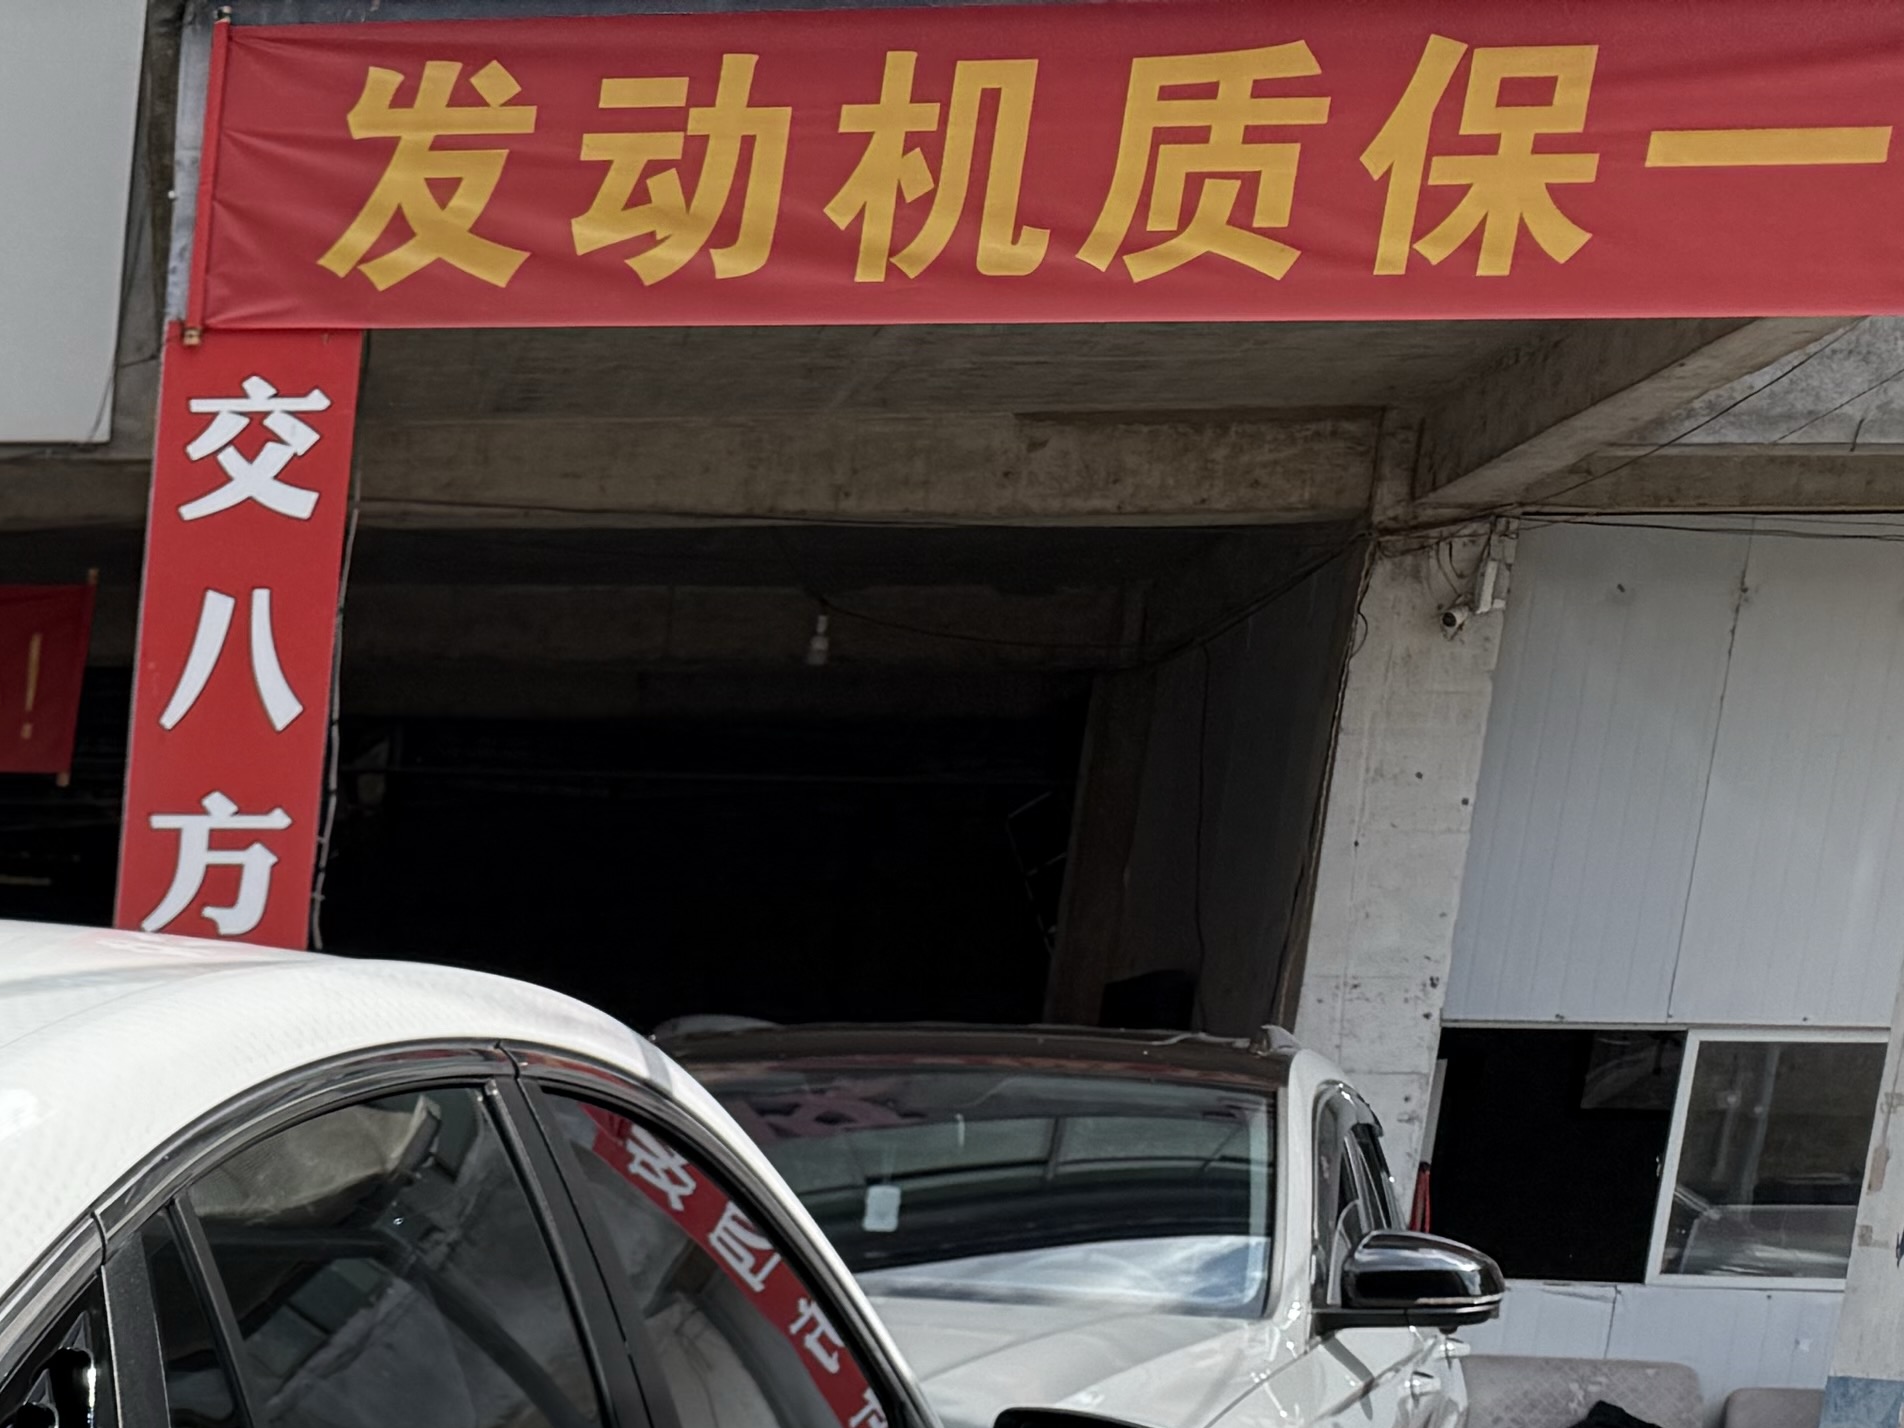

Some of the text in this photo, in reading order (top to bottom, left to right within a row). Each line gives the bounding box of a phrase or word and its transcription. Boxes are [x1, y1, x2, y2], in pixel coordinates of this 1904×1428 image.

[318, 34, 1892, 292] 发动机质保一
[140, 375, 334, 939] 交八方
